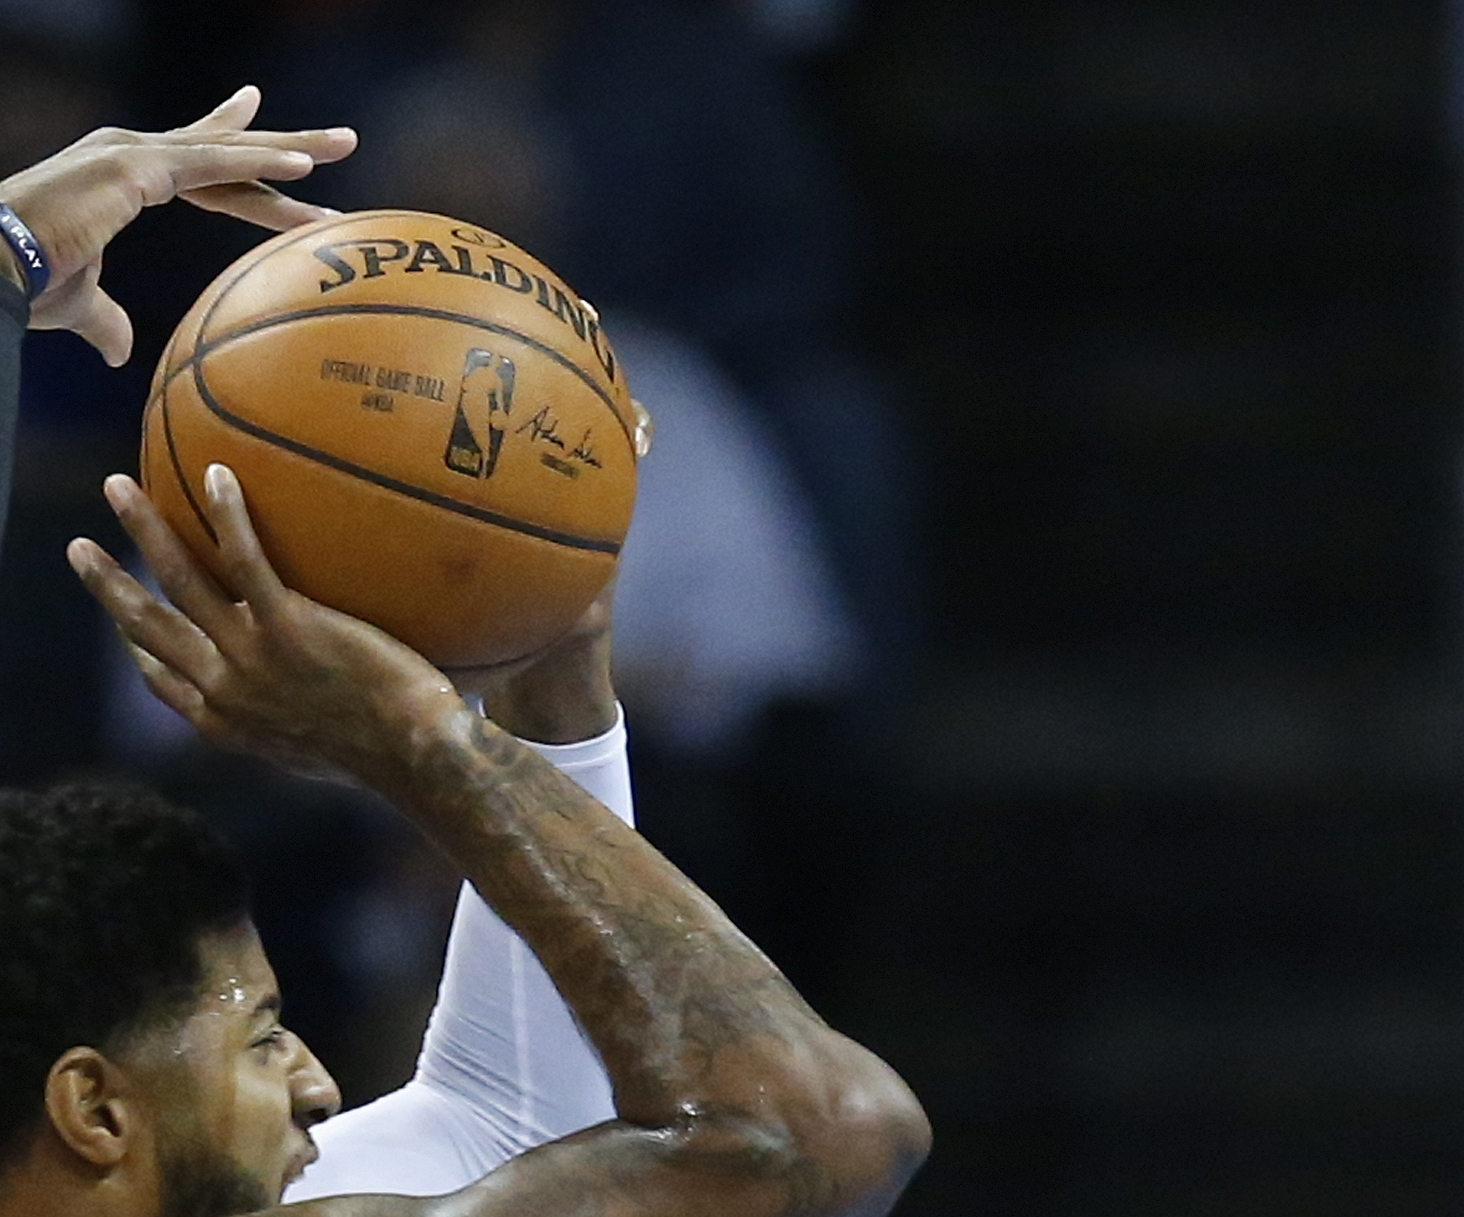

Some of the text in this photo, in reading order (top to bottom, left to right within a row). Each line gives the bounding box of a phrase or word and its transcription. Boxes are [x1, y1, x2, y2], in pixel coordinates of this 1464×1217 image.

[10, 225, 43, 269] PLAY
[313, 238, 615, 384] SPALDING
[414, 373, 445, 402] BALL
